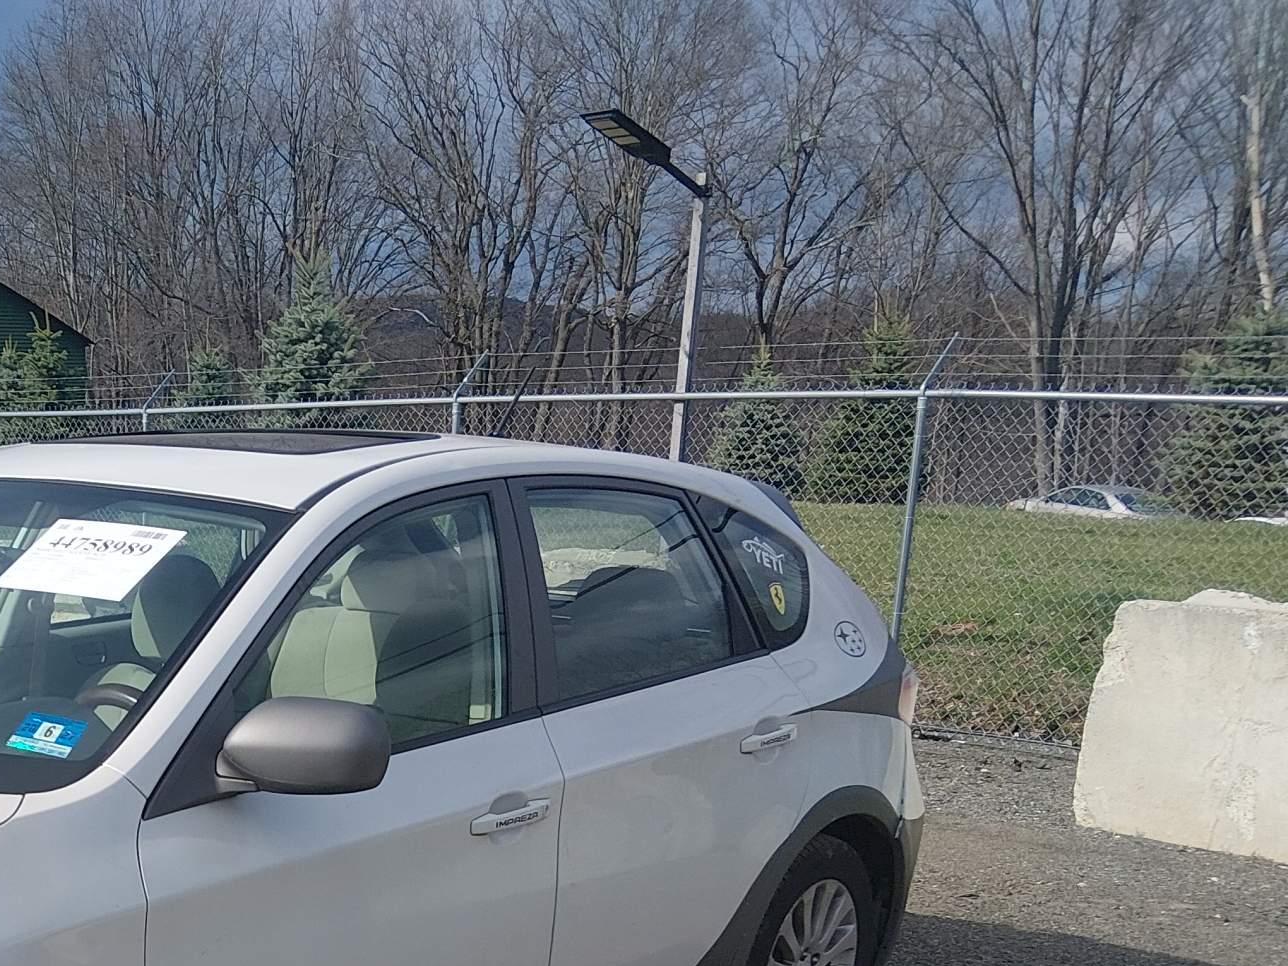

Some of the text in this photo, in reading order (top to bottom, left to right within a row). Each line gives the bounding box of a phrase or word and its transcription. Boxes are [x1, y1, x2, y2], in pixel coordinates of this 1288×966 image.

[49, 535, 153, 557] 44758989
[752, 546, 784, 575] YETI
[44, 725, 57, 738] 6
[495, 811, 539, 828] IMPREZA
